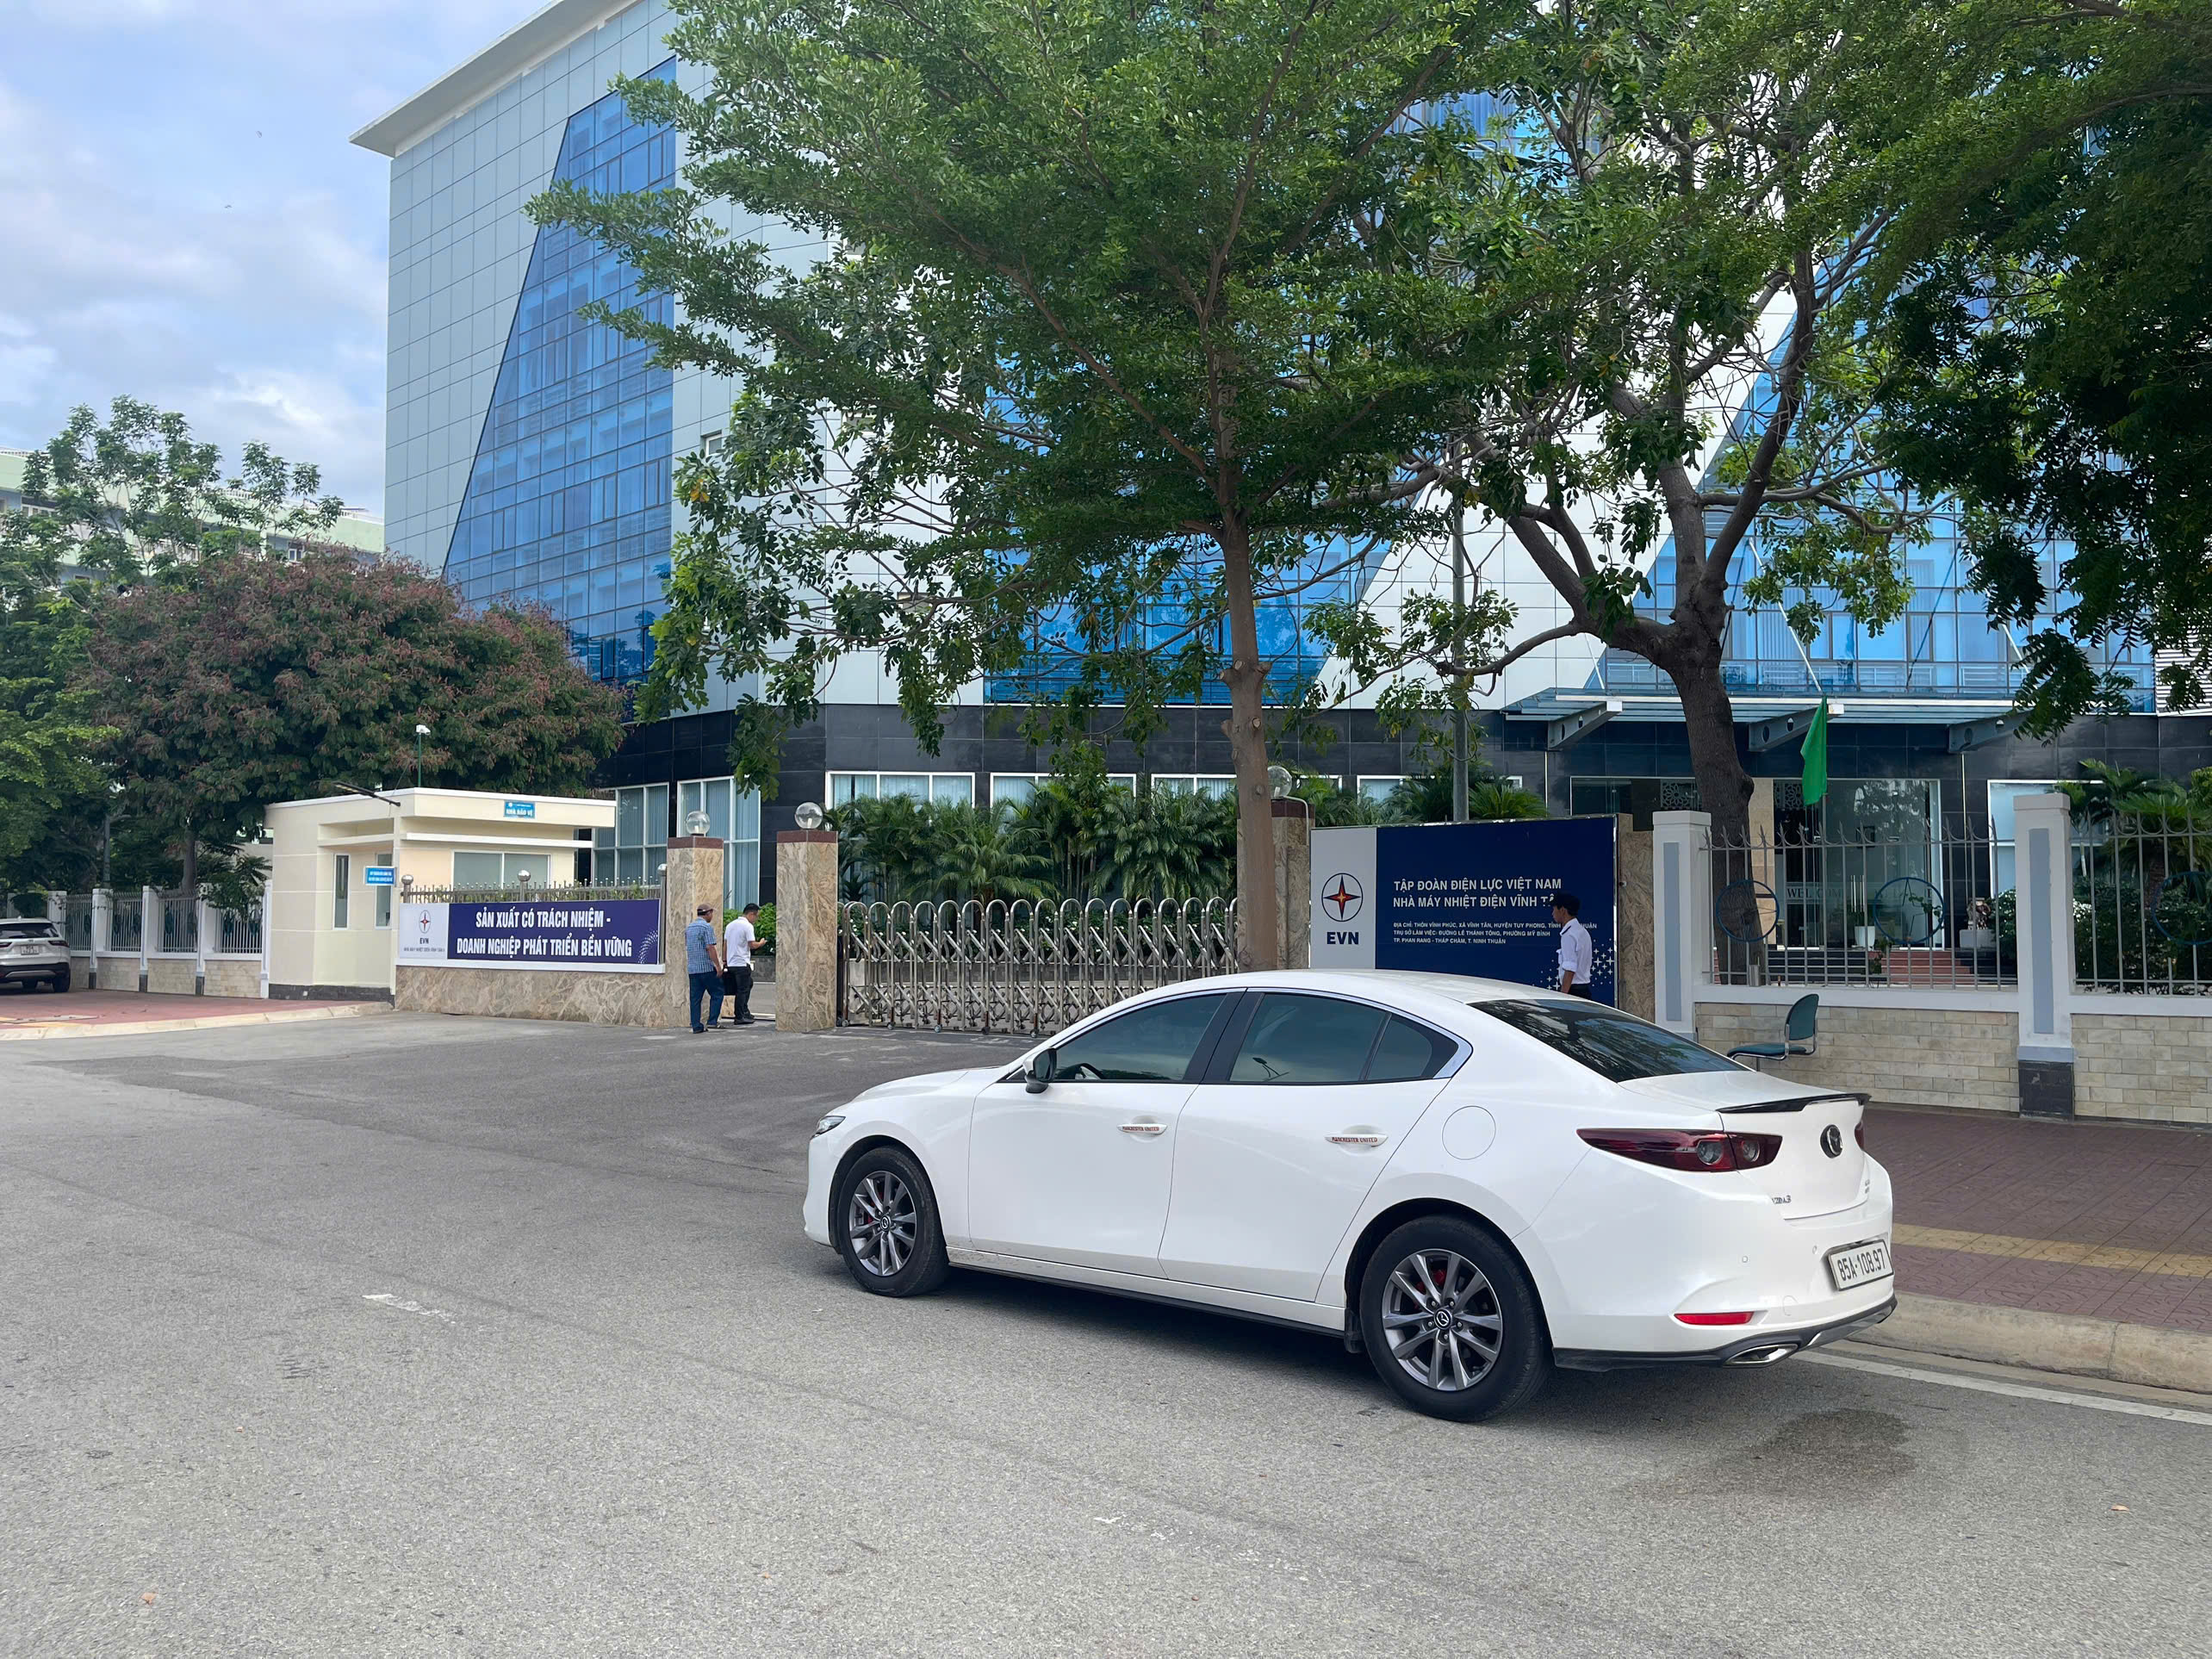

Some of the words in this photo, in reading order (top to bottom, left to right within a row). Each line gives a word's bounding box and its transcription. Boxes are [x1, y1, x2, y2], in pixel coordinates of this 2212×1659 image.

[1394, 879, 1414, 893] TẬP
[1417, 878, 1447, 891] ĐOÀN
[1451, 877, 1476, 892] ĐIỆN
[1480, 878, 1503, 892] LỰC
[1507, 876, 1532, 892] VIỆT
[1535, 879, 1562, 890] NAM
[1393, 895, 1415, 908] NHÀ
[1418, 894, 1440, 907] MÁY
[1444, 893, 1476, 909] NHIỆT
[1480, 893, 1507, 909] ĐIỆN
[1510, 893, 1538, 907] VĨNH
[475, 907, 494, 928] SẢN
[496, 906, 519, 928] XUẤT
[521, 908, 534, 928] CÓ
[537, 907, 569, 928] TRÁCH
[570, 907, 604, 931] NHIỆM
[457, 938, 485, 954] DOANH
[488, 935, 521, 958] NGHIỆP
[523, 935, 547, 955] PHÁT
[550, 932, 579, 956] TRIỂN
[581, 934, 602, 956] BỀN
[605, 936, 632, 957] VỮNG
[1327, 931, 1359, 945] EVN
